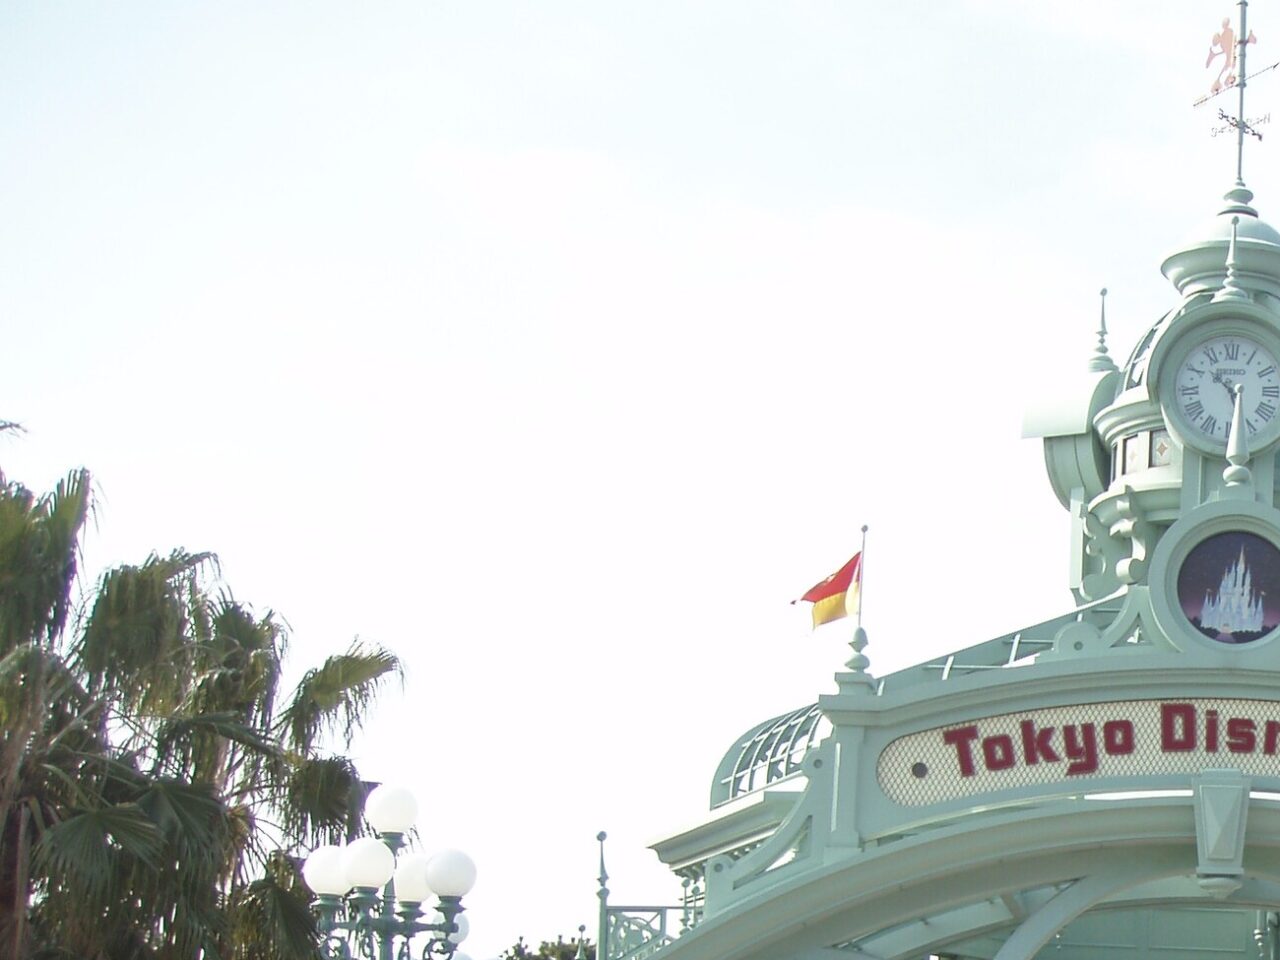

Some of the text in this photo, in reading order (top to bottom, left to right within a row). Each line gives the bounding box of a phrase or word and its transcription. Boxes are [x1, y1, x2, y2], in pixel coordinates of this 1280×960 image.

[1203, 346, 1219, 366] XI
[1223, 343, 1240, 361] XII
[1186, 363, 1205, 379] X
[1257, 365, 1276, 379] II
[1181, 385, 1200, 397] IX
[1262, 386, 1280, 398] III
[1184, 400, 1205, 422] VIII
[1200, 415, 1217, 435] VII
[943, 719, 1135, 778] Tokyo
